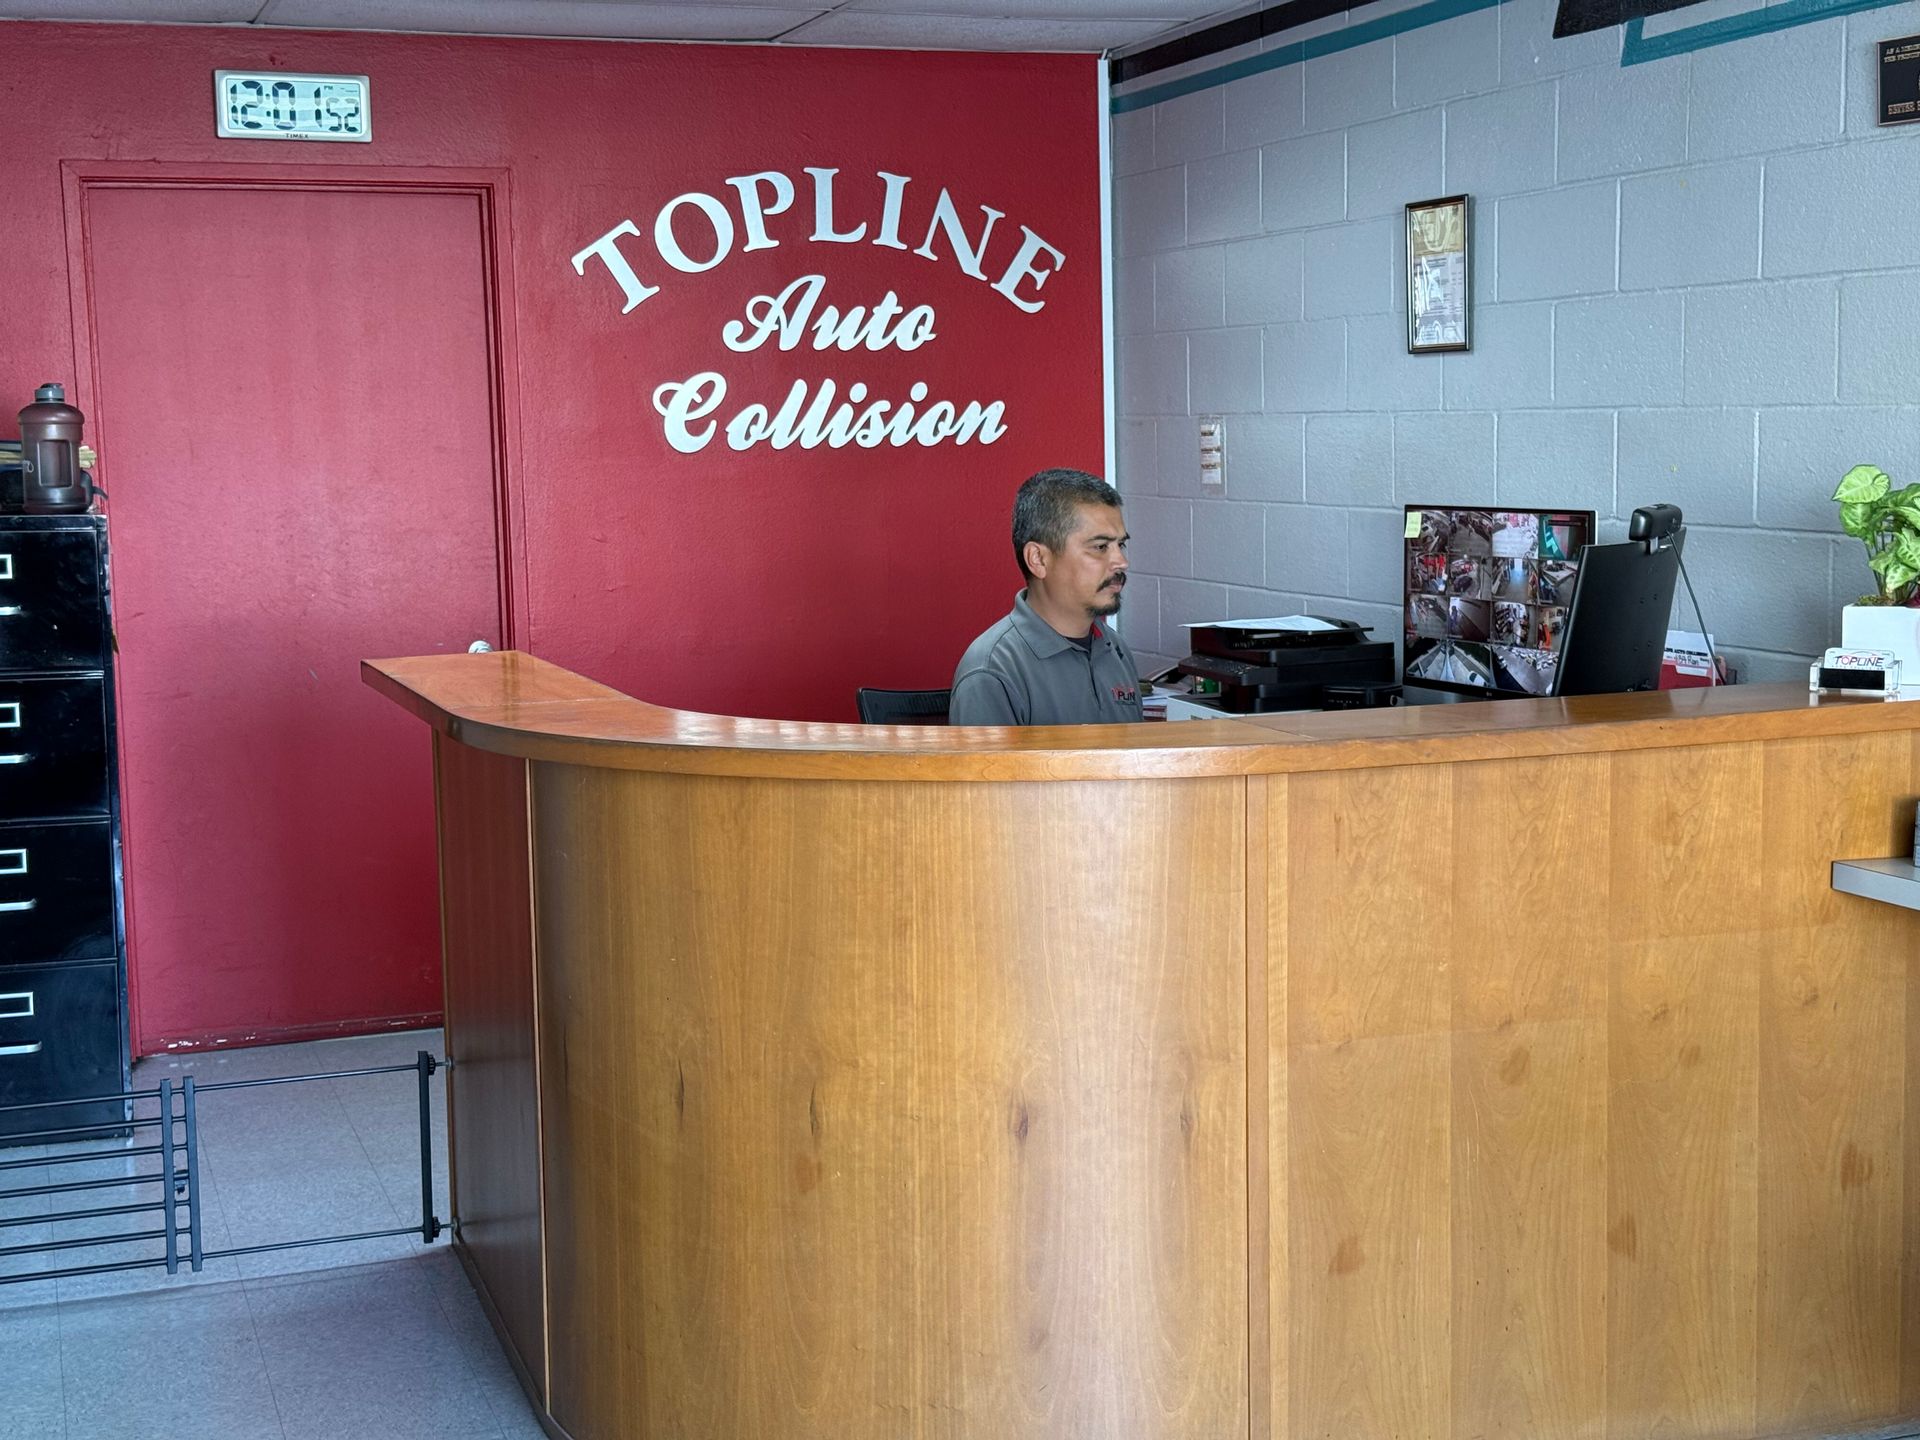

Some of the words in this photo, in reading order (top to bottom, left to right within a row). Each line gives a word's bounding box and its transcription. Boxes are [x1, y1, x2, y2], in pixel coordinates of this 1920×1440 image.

[230, 80, 323, 130] 12:01
[570, 166, 1066, 315] TOPLINE
[722, 273, 937, 353] Auto
[652, 371, 1008, 453] Collision
[1834, 656, 1884, 667] TOPLINE
